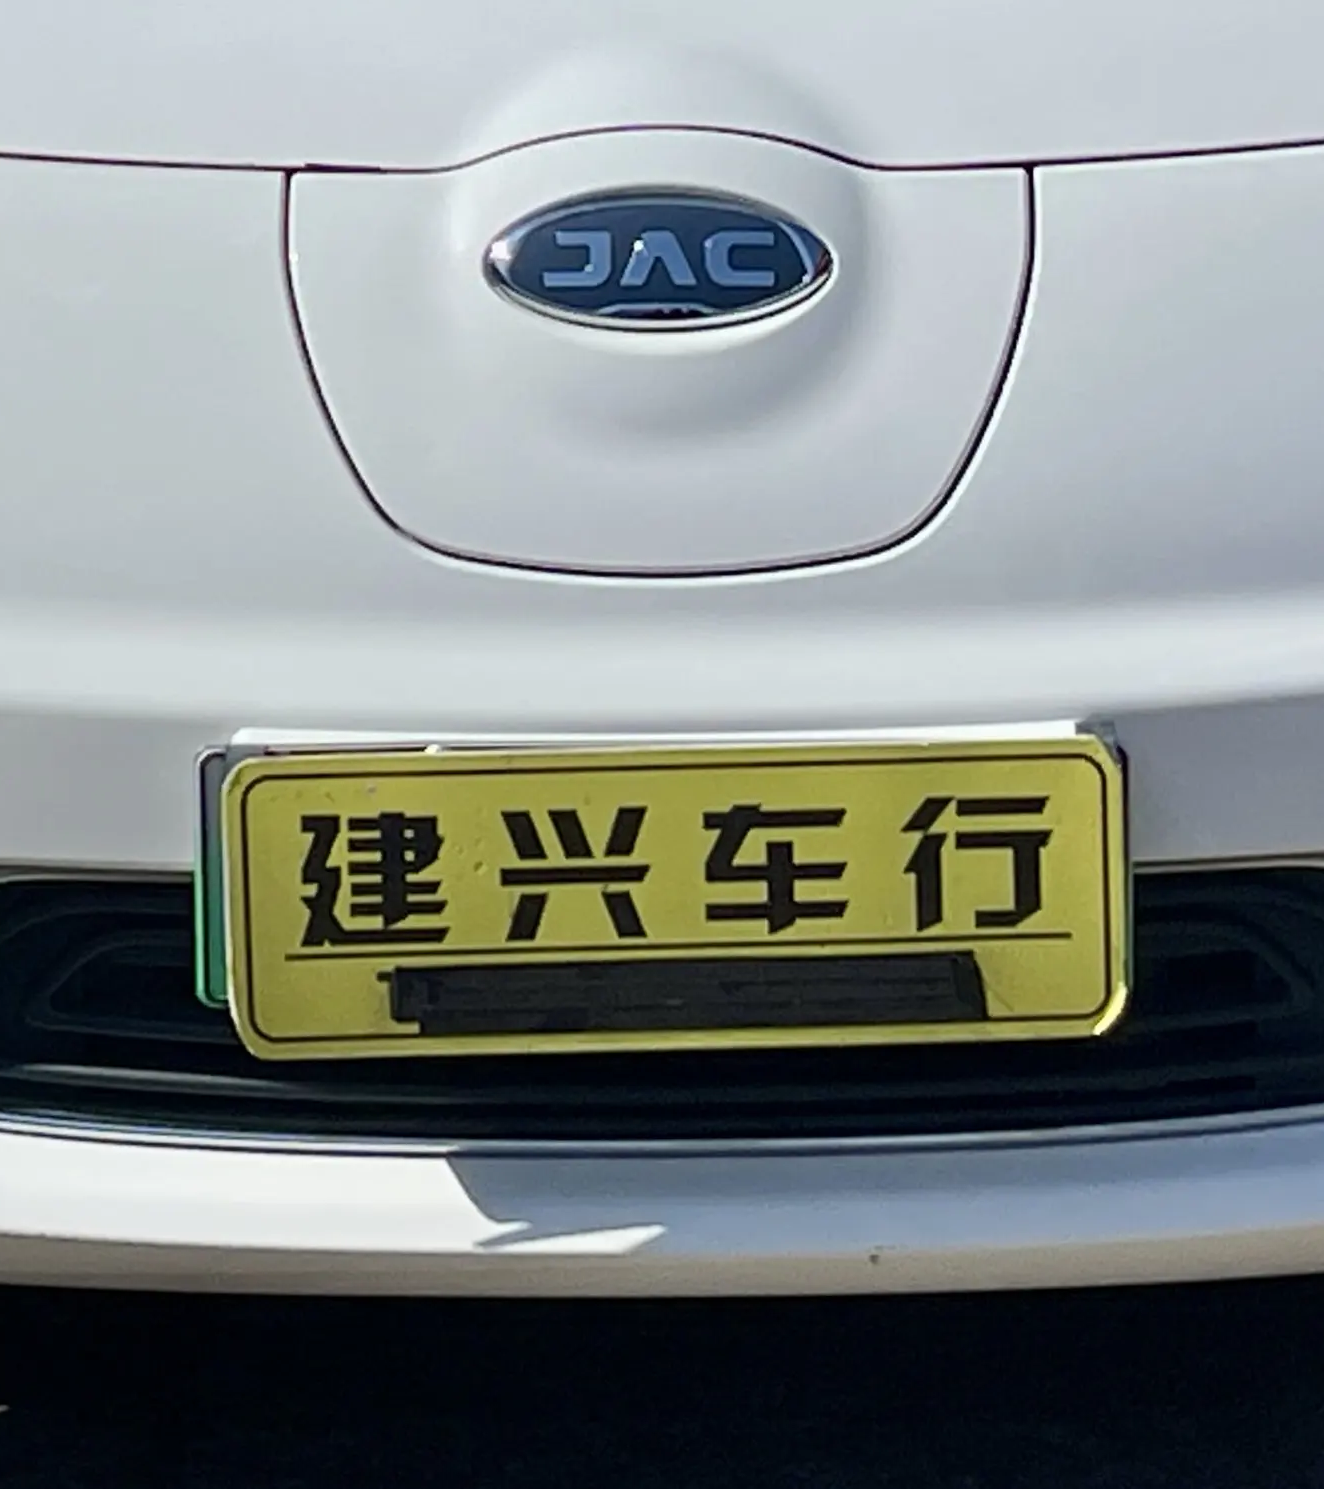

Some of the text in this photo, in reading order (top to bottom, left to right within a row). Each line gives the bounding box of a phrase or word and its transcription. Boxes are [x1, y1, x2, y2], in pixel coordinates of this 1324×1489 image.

[542, 227, 779, 291] JAC
[300, 796, 1053, 945] 建兴车行
